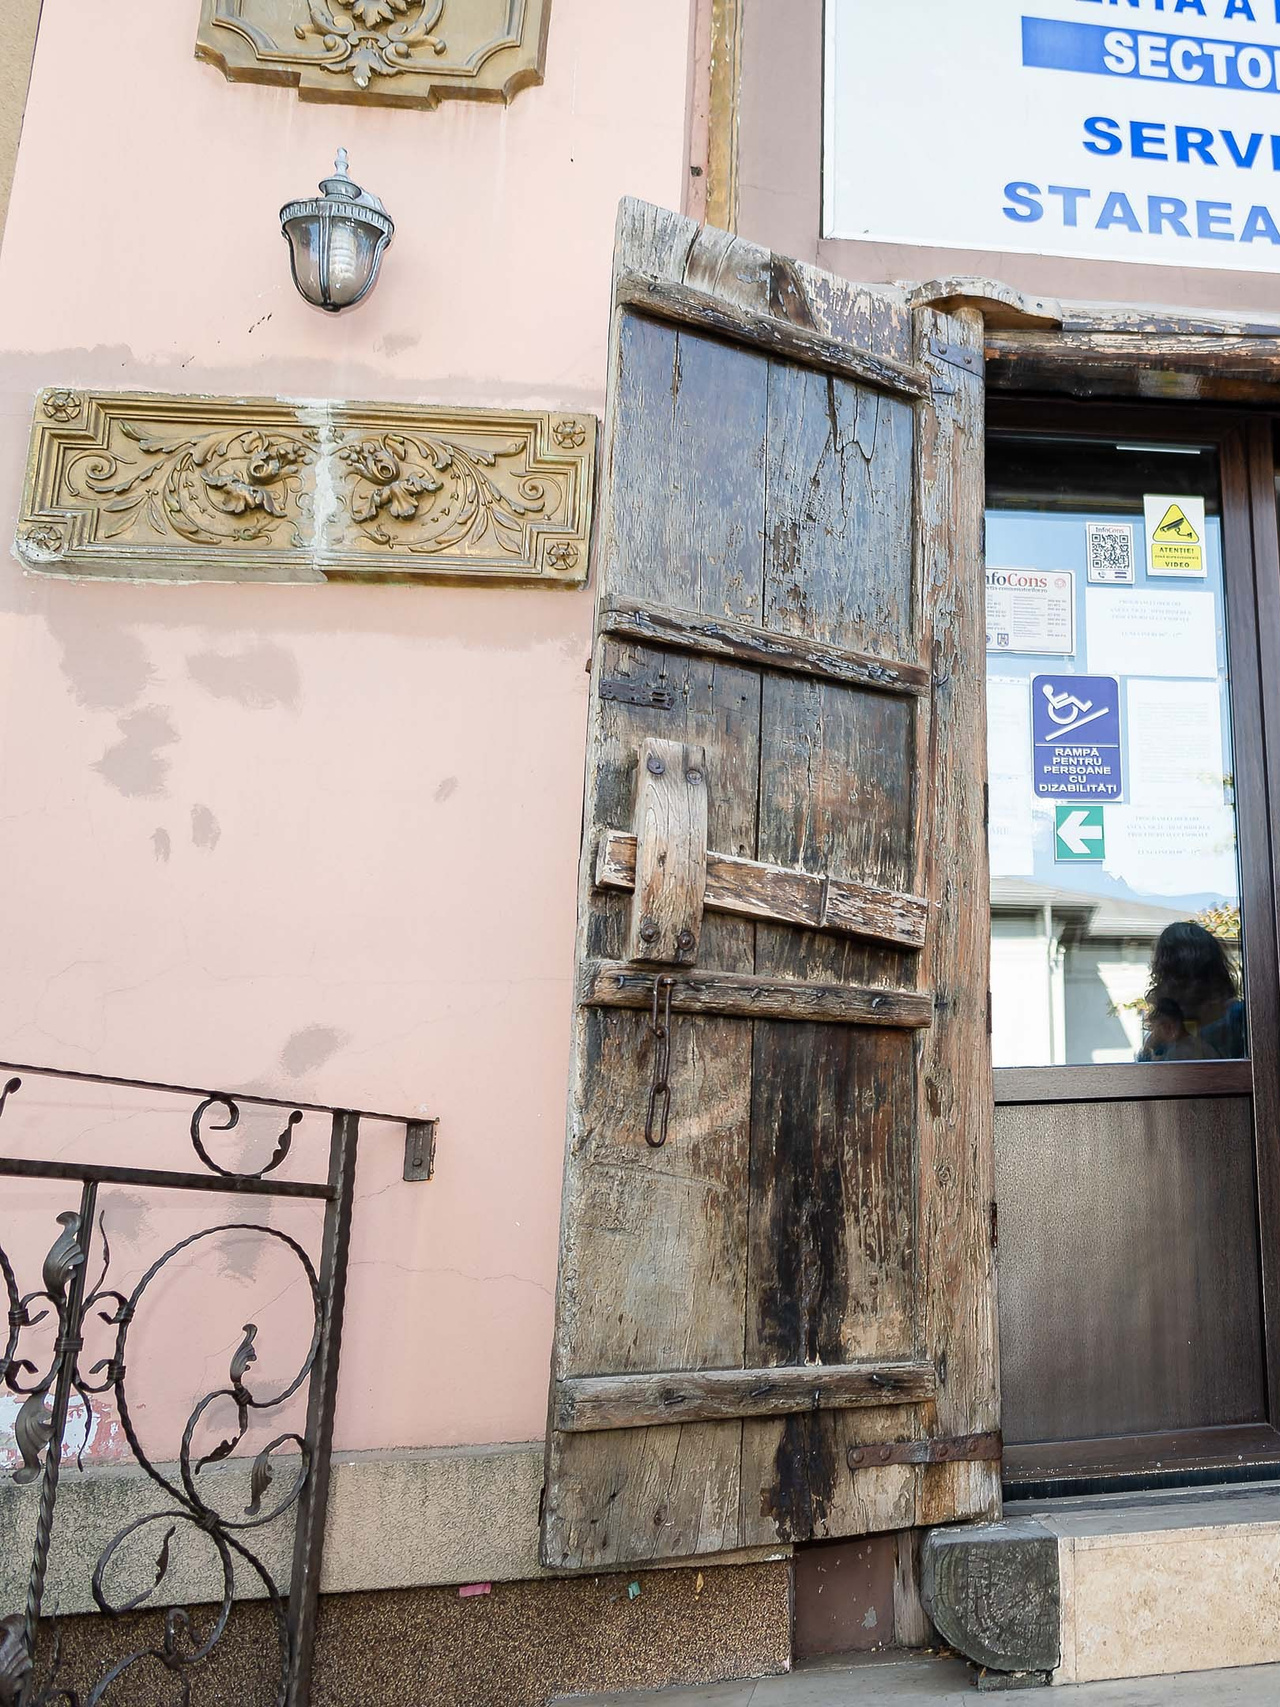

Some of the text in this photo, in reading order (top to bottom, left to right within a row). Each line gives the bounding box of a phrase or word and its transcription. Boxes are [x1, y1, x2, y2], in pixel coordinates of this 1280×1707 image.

[1054, 747, 1100, 757] RAMPĂ
[1052, 757, 1102, 766] PENTRU
[1043, 765, 1112, 775] PERSOANE
[1068, 775, 1087, 783] CU
[1039, 783, 1117, 795] DIZABILITĂȚI
